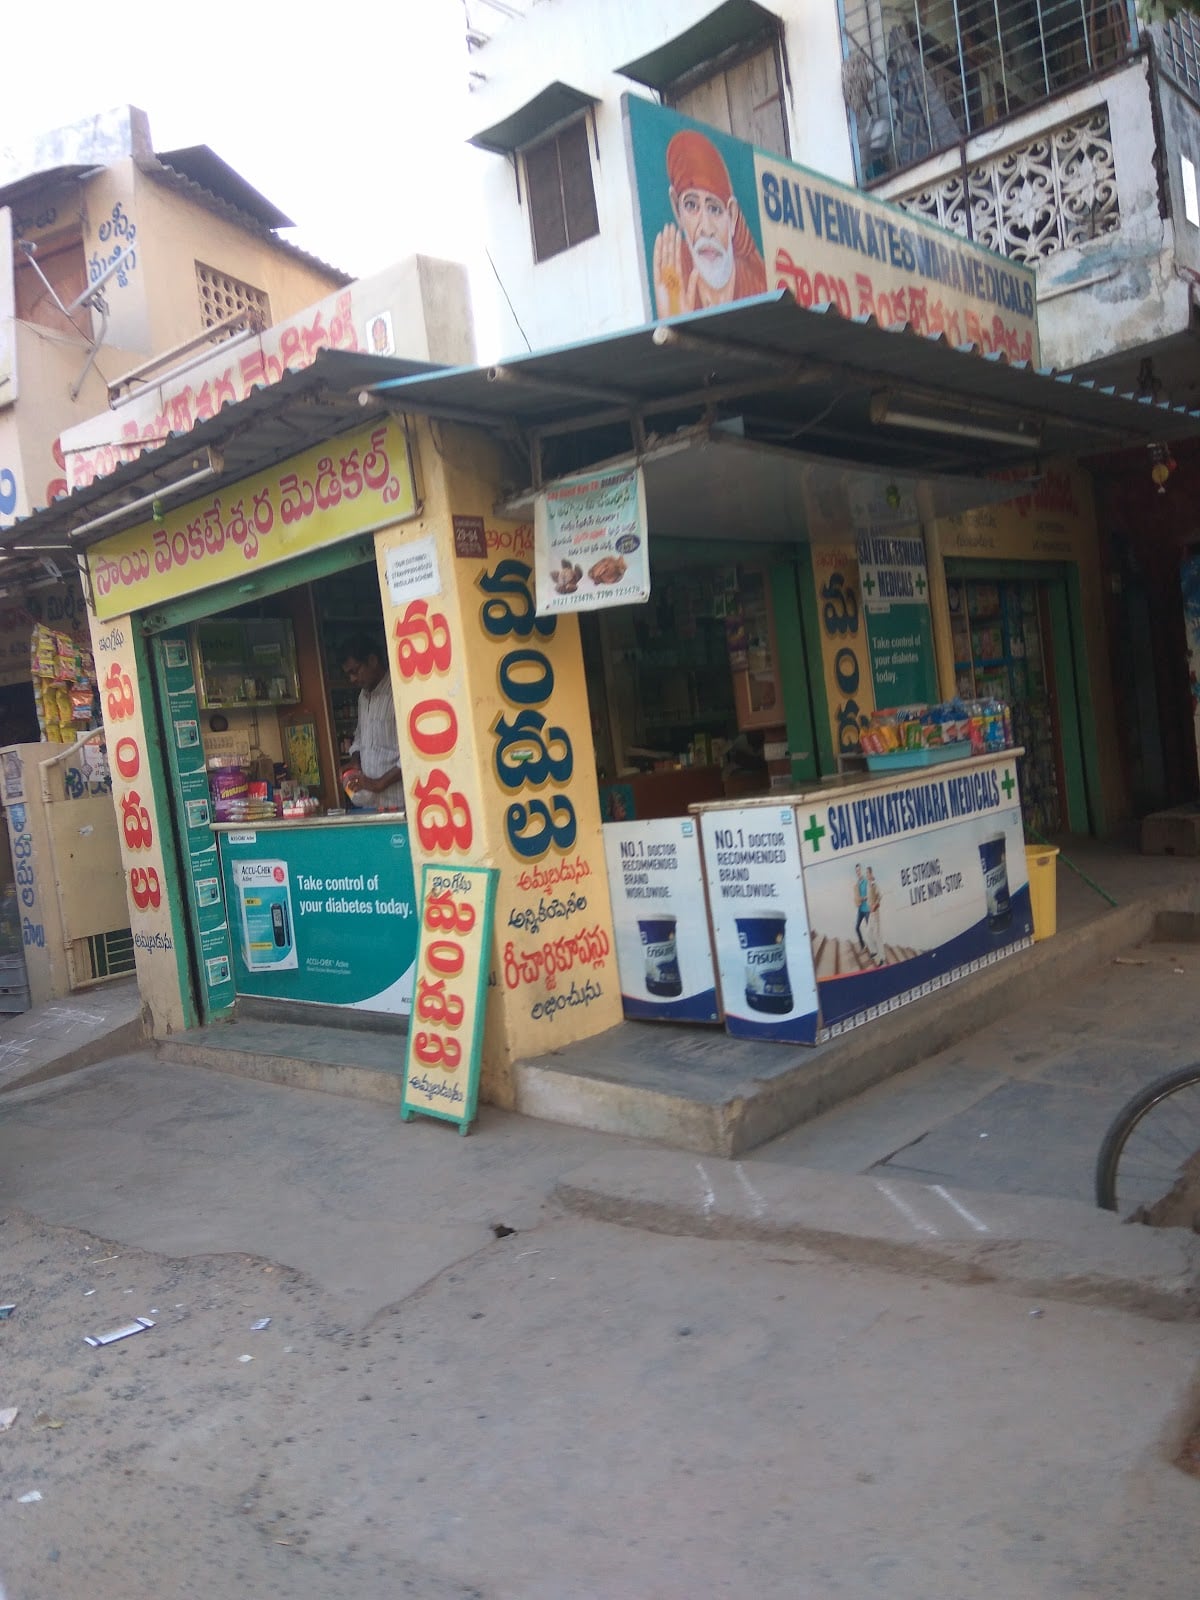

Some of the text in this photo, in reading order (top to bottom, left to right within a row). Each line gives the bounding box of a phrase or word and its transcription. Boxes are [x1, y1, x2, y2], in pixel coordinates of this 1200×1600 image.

[762, 171, 805, 231] SAI
[960, 251, 1034, 319] MEDICALS
[95, 427, 401, 595] సాయి వెంకటేశ్వర మెడికల్స్
[877, 570, 914, 597] MEDICALS
[872, 634, 921, 648] Take control of
[874, 652, 919, 668] your diabetes
[828, 769, 1001, 851] SAI VENKATESWARA MEDICALS
[715, 828, 786, 849] NO.1 DOCTOR
[620, 840, 677, 857] NO.1 DOCTOR
[622, 859, 678, 871] RECOMMENDED
[717, 849, 787, 865] RECOMMENDED
[297, 875, 378, 891] Take control of
[623, 872, 649, 885] BRAND
[719, 868, 749, 882] BRAND
[900, 867, 912, 888] BE
[625, 886, 673, 899] WORLDWIDE.
[721, 884, 779, 899] WORLDWIDE.
[909, 885, 928, 907] LIVE
[299, 898, 413, 919] your diabetes today.
[646, 945, 674, 958] Ensure
[746, 950, 784, 966] Ensure
